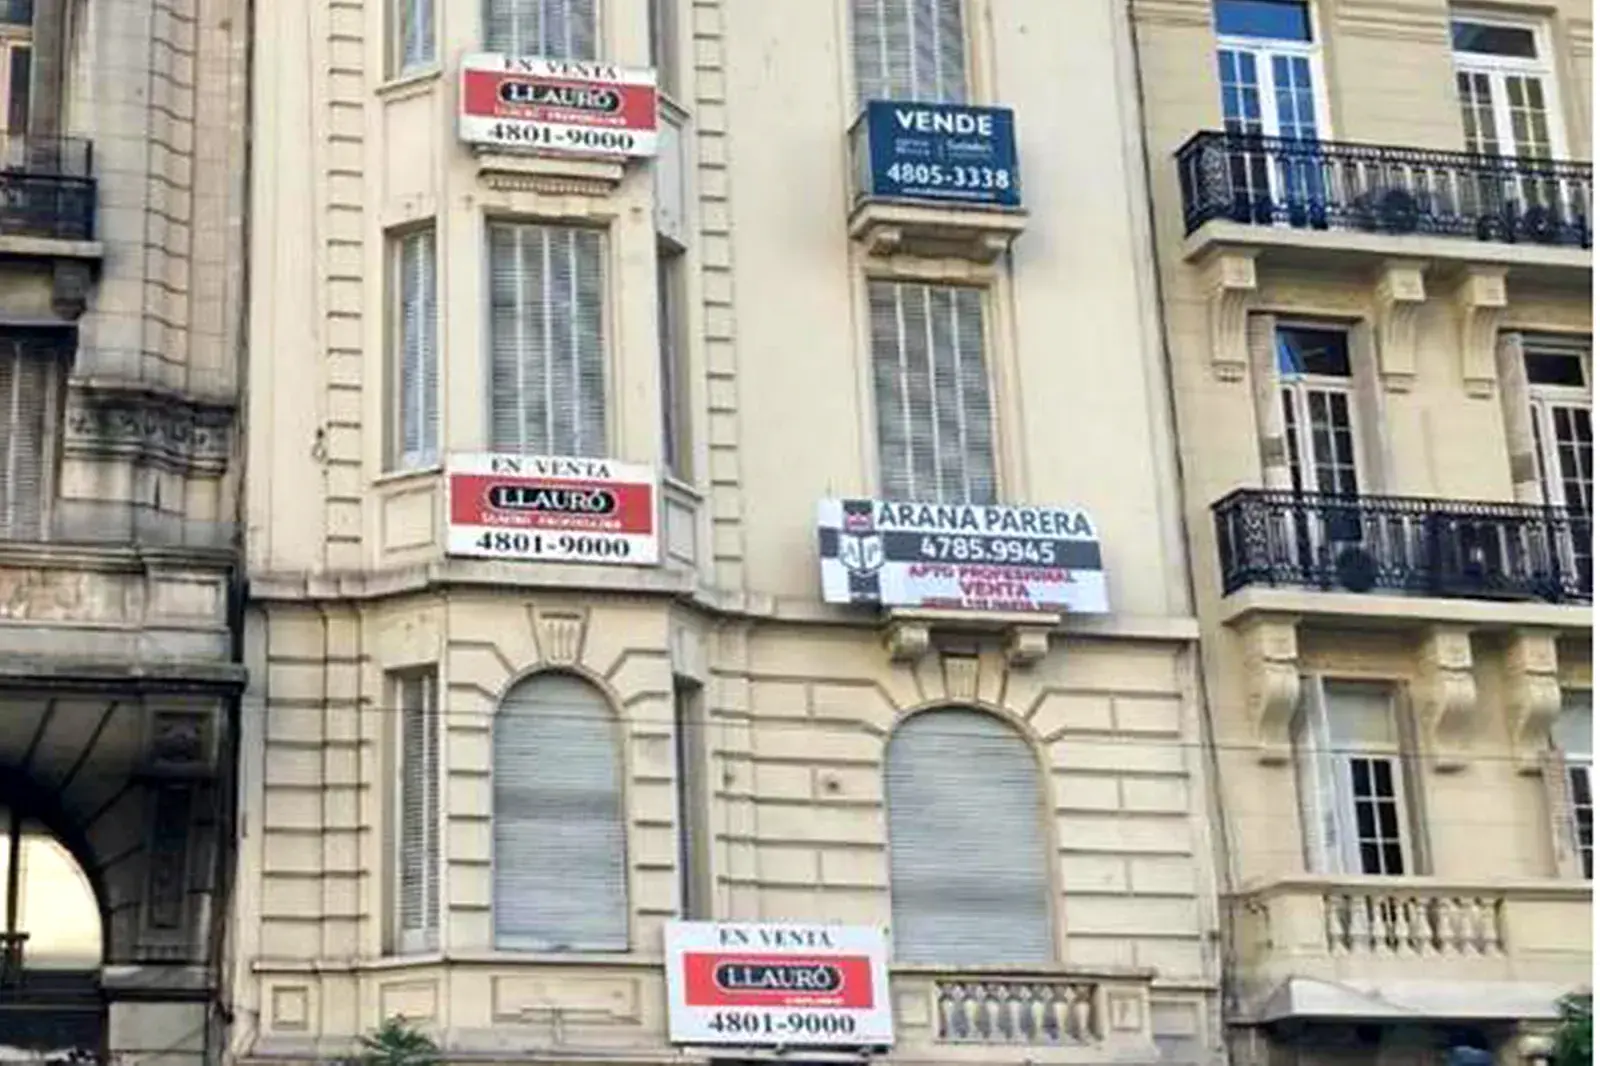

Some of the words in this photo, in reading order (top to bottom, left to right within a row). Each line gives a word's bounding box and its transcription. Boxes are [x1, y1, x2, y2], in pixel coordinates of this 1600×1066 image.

[895, 108, 993, 136] VENDE
[488, 123, 634, 150] 4801-9000
[886, 162, 1010, 189] 4805-3338
[491, 458, 521, 472] EN
[535, 460, 611, 478] VENTA
[500, 488, 606, 511] LLAURÓ
[878, 503, 979, 530] ARANA
[984, 510, 1093, 536] PARERA
[476, 532, 630, 556] 4801-9000
[919, 538, 1057, 564] 4785.9945
[909, 565, 952, 578] APTO
[959, 567, 1077, 583] PROFESIONAL
[960, 582, 1030, 598] VENTA
[719, 929, 749, 945] EN
[760, 930, 835, 947] VENTA
[728, 964, 831, 989] LLAURÓ
[708, 1014, 856, 1038] 4801-9000
